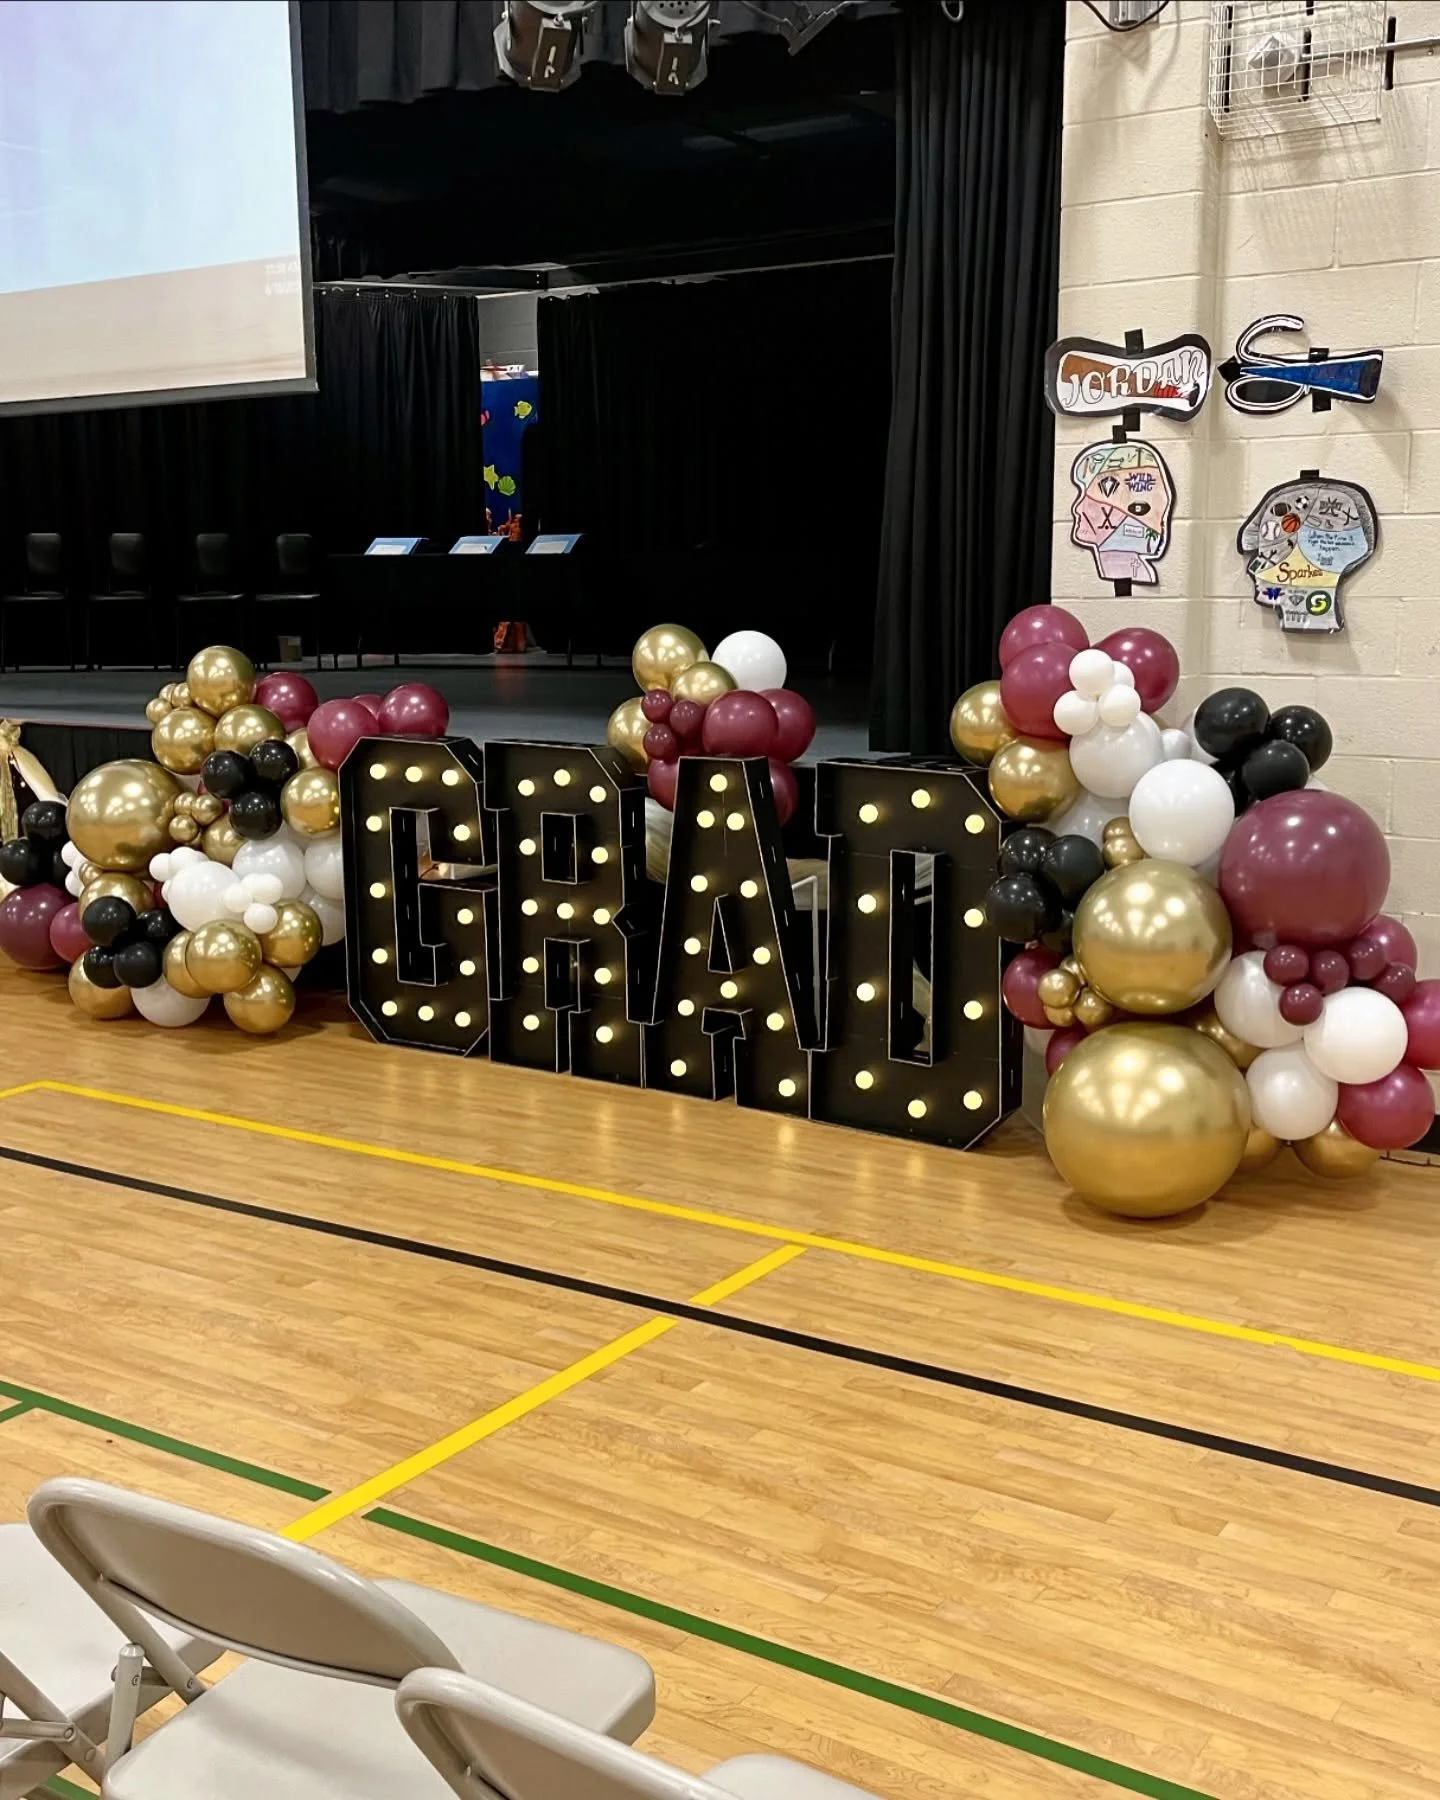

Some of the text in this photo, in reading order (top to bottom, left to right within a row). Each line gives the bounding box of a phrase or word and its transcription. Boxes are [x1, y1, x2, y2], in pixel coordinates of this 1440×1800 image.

[1060, 350, 1206, 408] JORDAN
[1127, 481, 1153, 493] WING
[1128, 472, 1153, 482] WILD
[338, 735, 1023, 1150] GRAD
